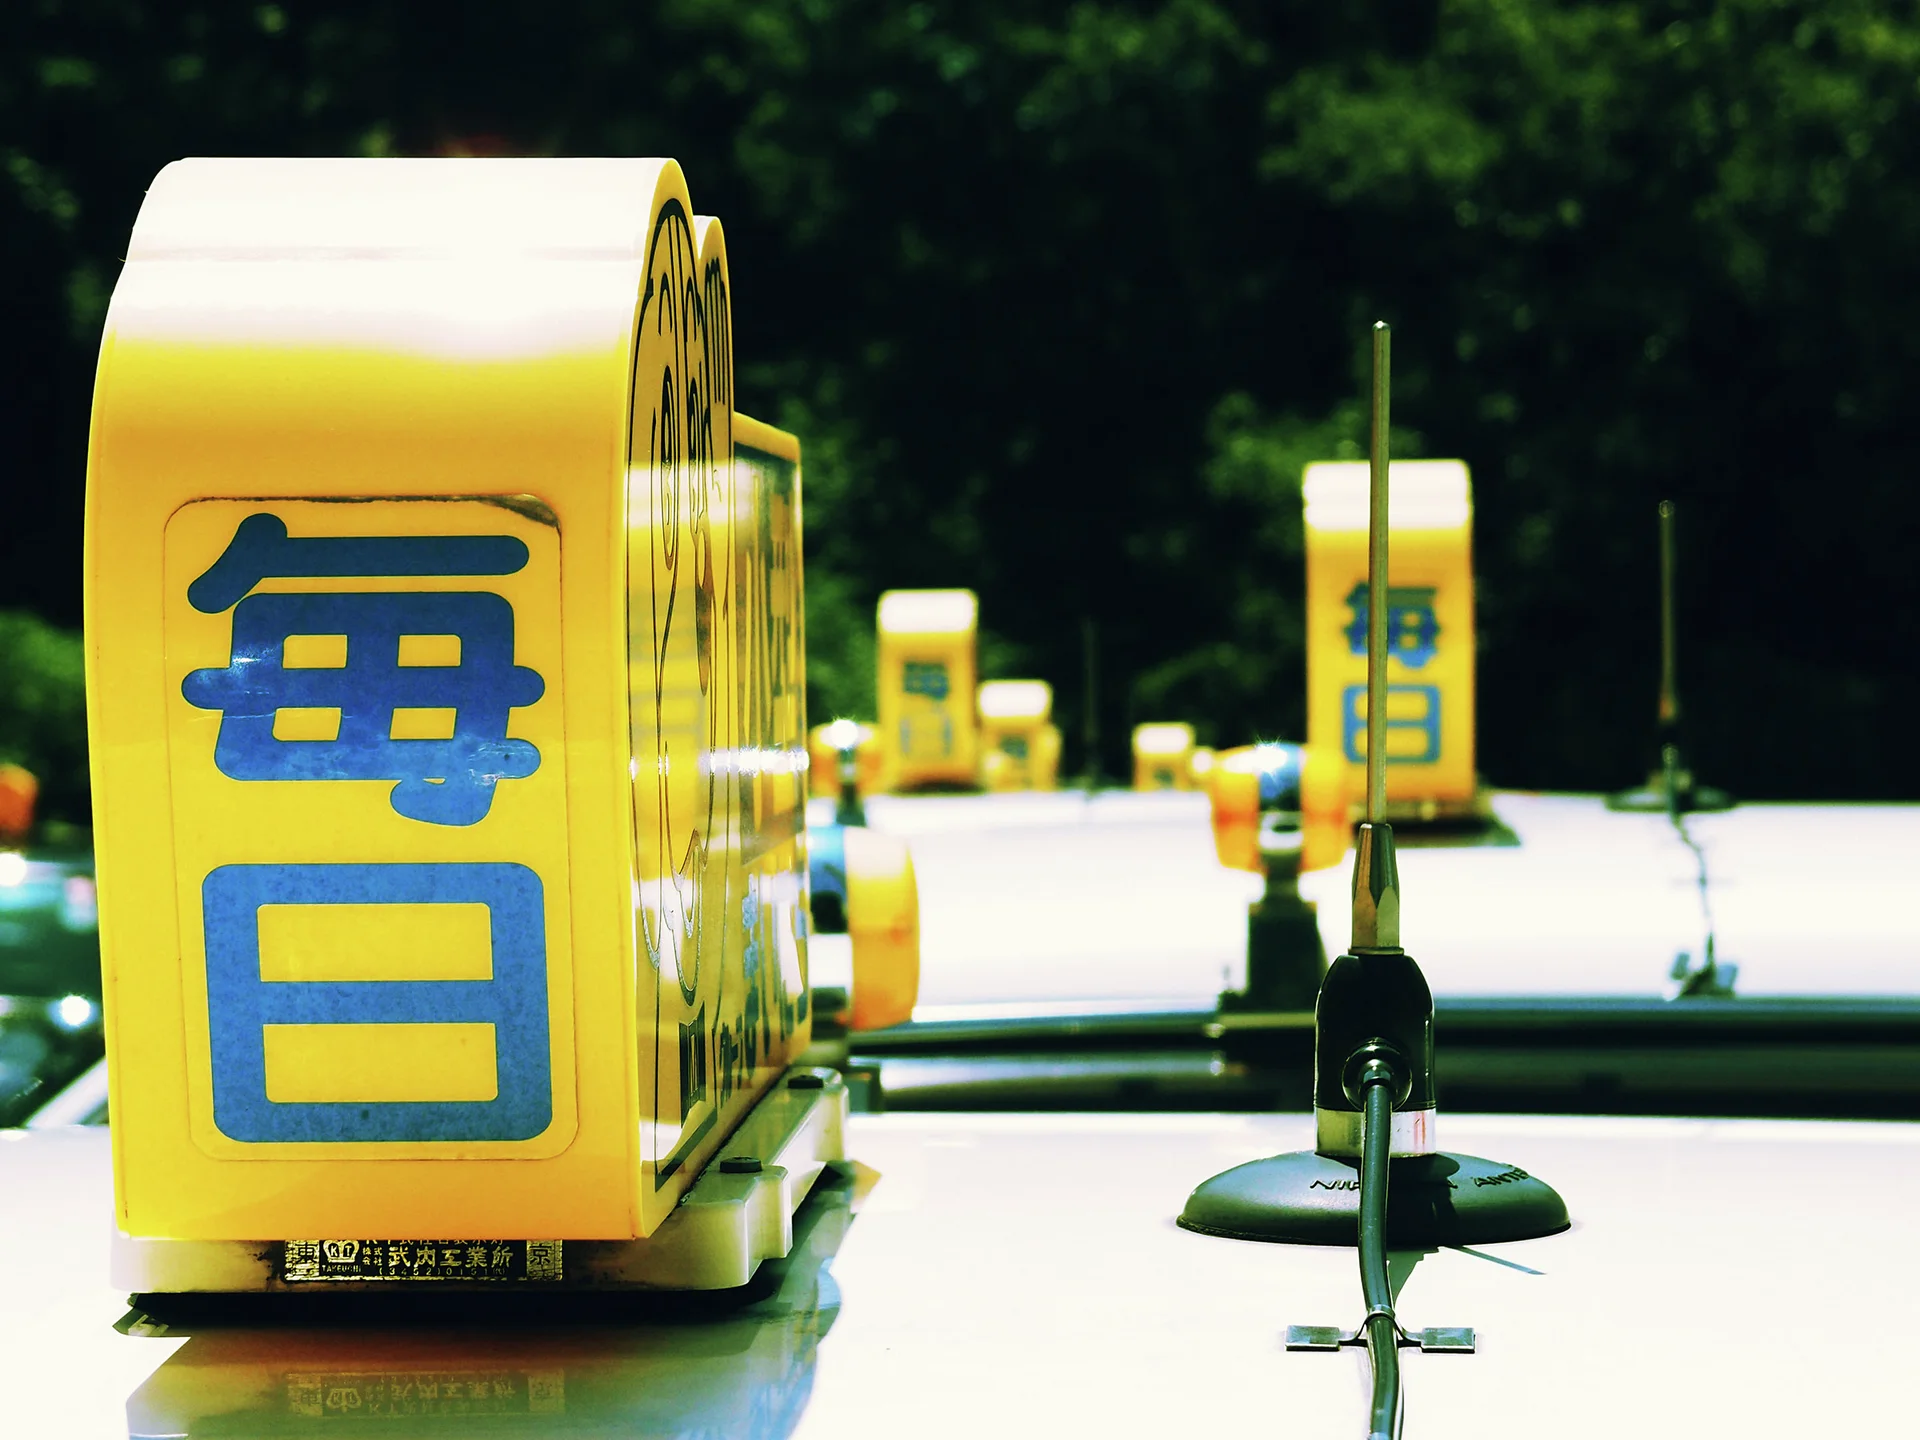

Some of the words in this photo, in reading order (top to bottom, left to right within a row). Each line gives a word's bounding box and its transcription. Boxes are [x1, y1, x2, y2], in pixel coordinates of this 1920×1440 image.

[1343, 580, 1441, 764] 毎日
[182, 513, 552, 1142] 毎日
[388, 1246, 513, 1268] 武内工業所
